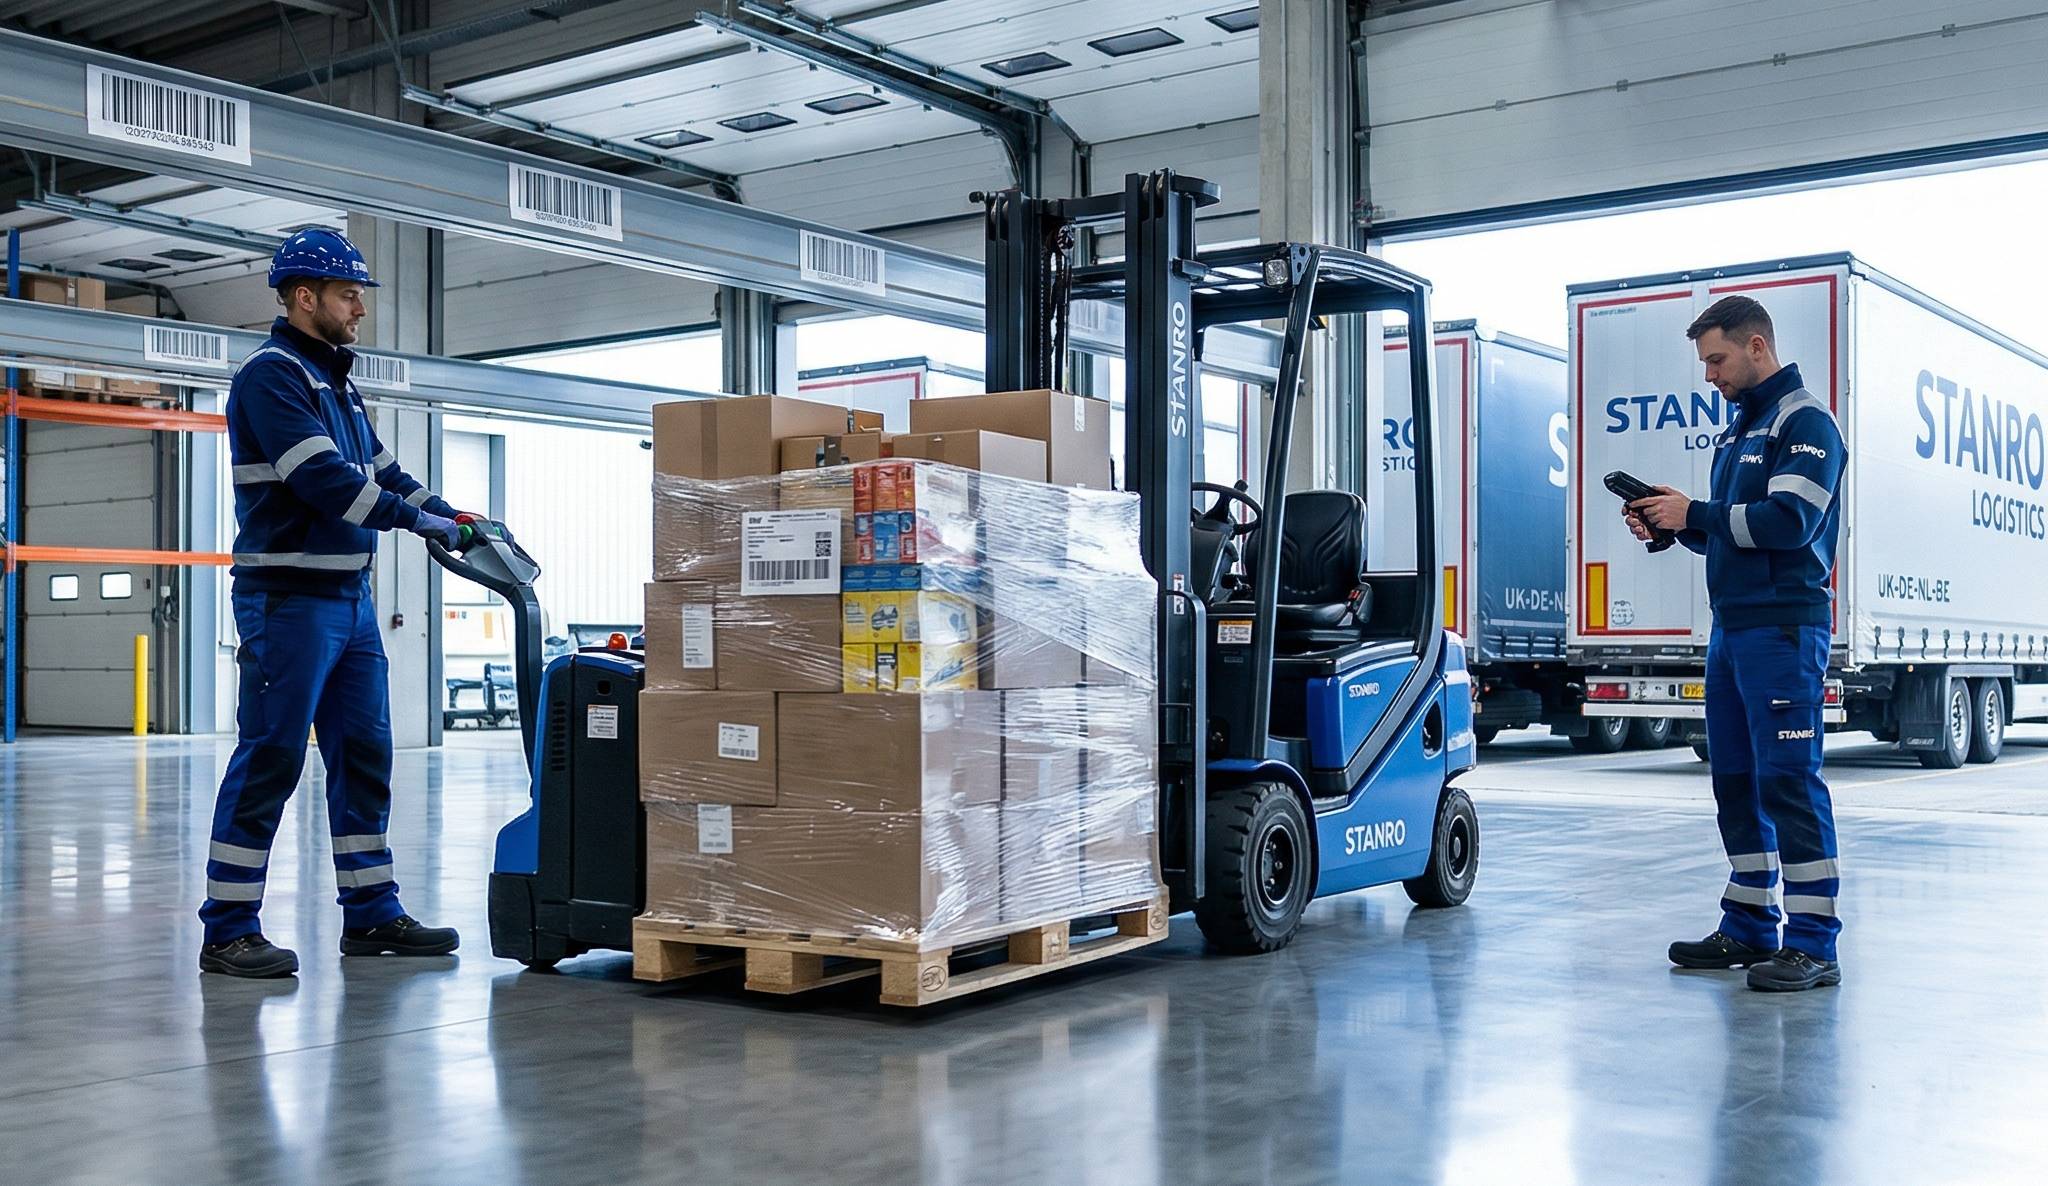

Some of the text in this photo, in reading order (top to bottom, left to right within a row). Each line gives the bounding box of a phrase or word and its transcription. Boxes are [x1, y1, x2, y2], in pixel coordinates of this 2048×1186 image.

[1170, 301, 1187, 438] STANRO
[1915, 368, 2046, 490] STANRO
[1972, 488, 2046, 541] LOGISTICS
[1345, 818, 1406, 855] STANRO
